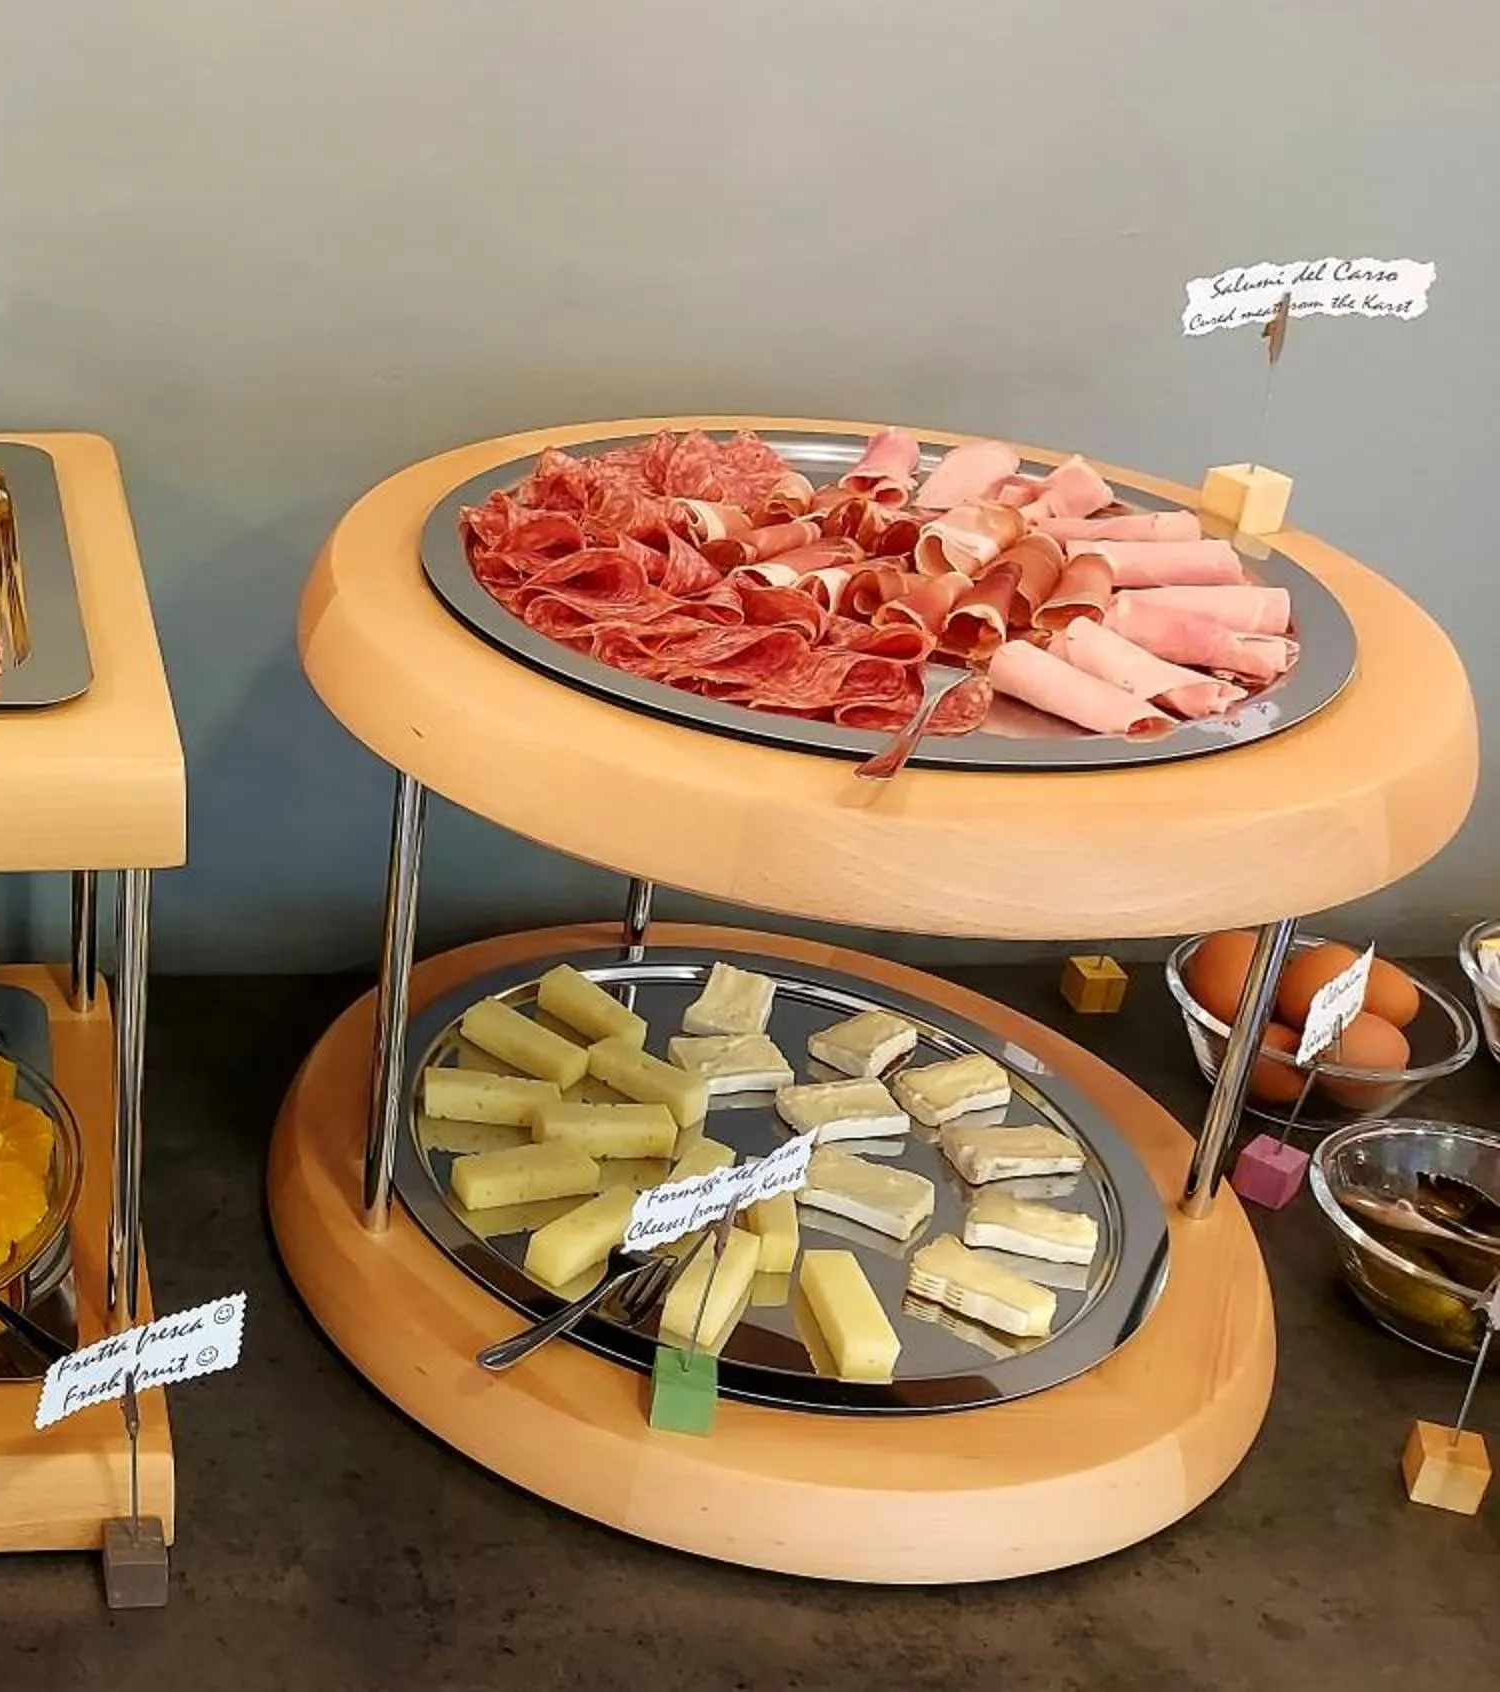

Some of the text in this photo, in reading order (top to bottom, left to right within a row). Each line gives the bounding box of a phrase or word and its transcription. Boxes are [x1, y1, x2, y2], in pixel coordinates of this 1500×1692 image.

[1210, 261, 1398, 299] Salumi del Carso
[1189, 307, 1236, 330] Cured
[1285, 300, 1324, 313] rom
[1331, 296, 1356, 309] the
[1361, 294, 1413, 314] Karst
[647, 1171, 724, 1207] Formaggi
[728, 1163, 760, 1182] del
[57, 1317, 206, 1381] Frutta fresca
[63, 1367, 123, 1411] Fresh
